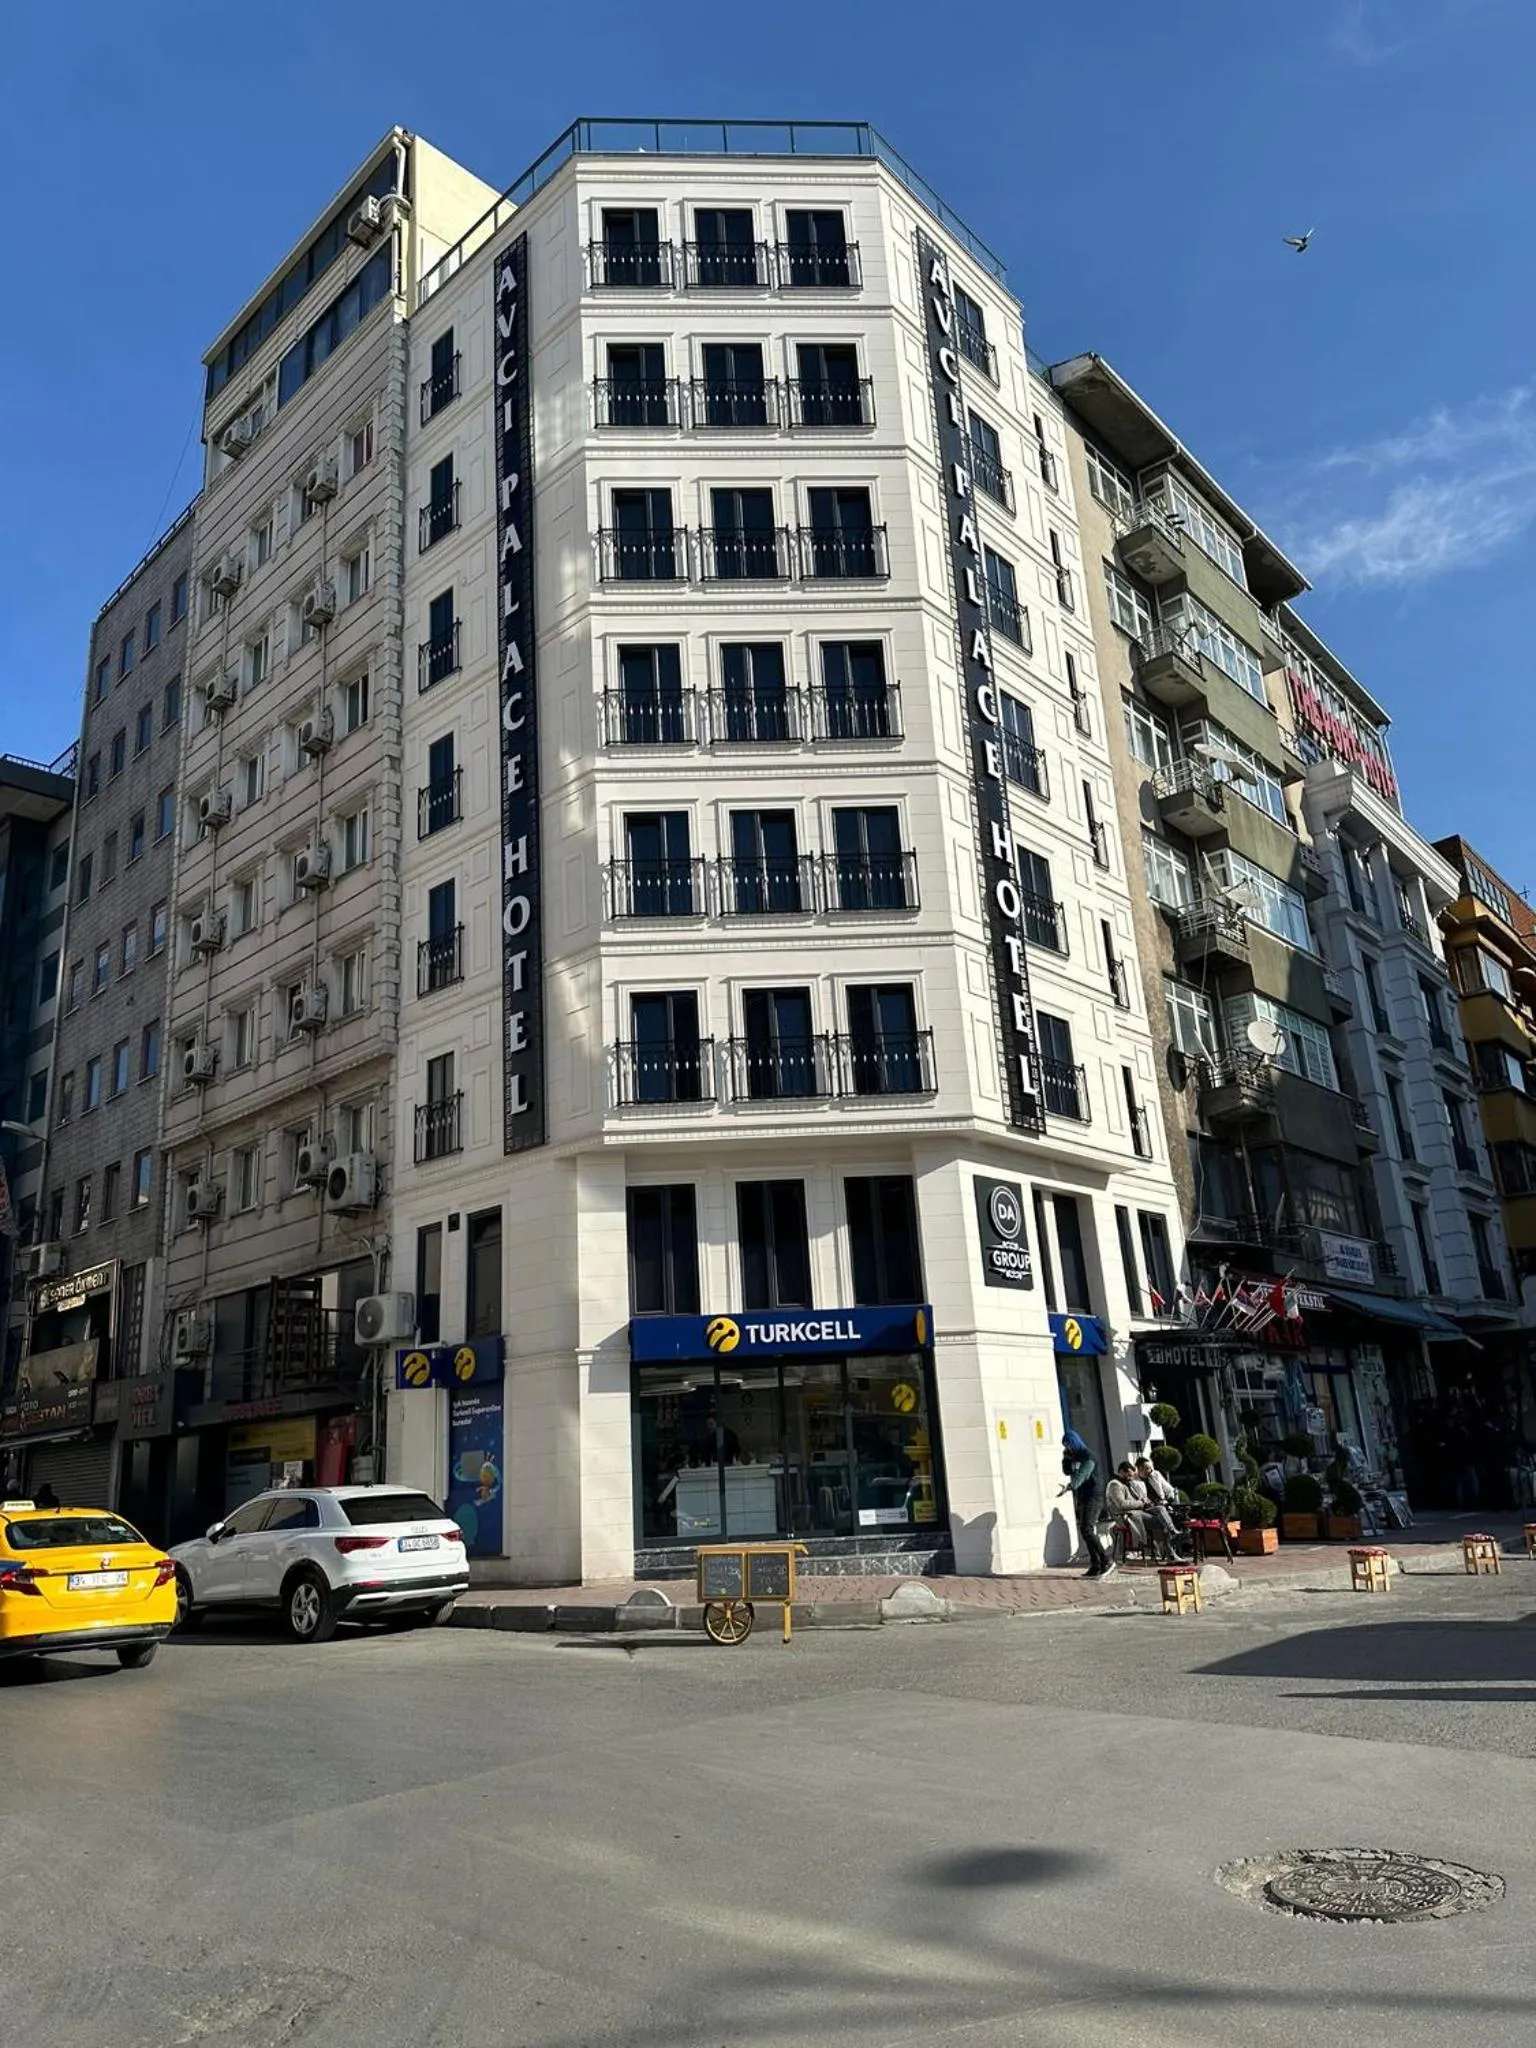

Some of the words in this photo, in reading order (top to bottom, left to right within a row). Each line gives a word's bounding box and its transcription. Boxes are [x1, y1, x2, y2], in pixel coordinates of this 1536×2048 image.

[496, 264, 519, 433] AVCI
[500, 471, 526, 795] PALACE
[929, 256, 960, 428] AVCI
[952, 460, 1003, 780] PALACE
[990, 820, 1038, 1096] HOTEL
[502, 834, 531, 1116] HOTEL
[993, 1250, 1031, 1270] GROUP
[998, 1203, 1016, 1221] DA
[745, 1320, 861, 1344] TURKCELL
[1165, 1346, 1205, 1367] HOTEL
